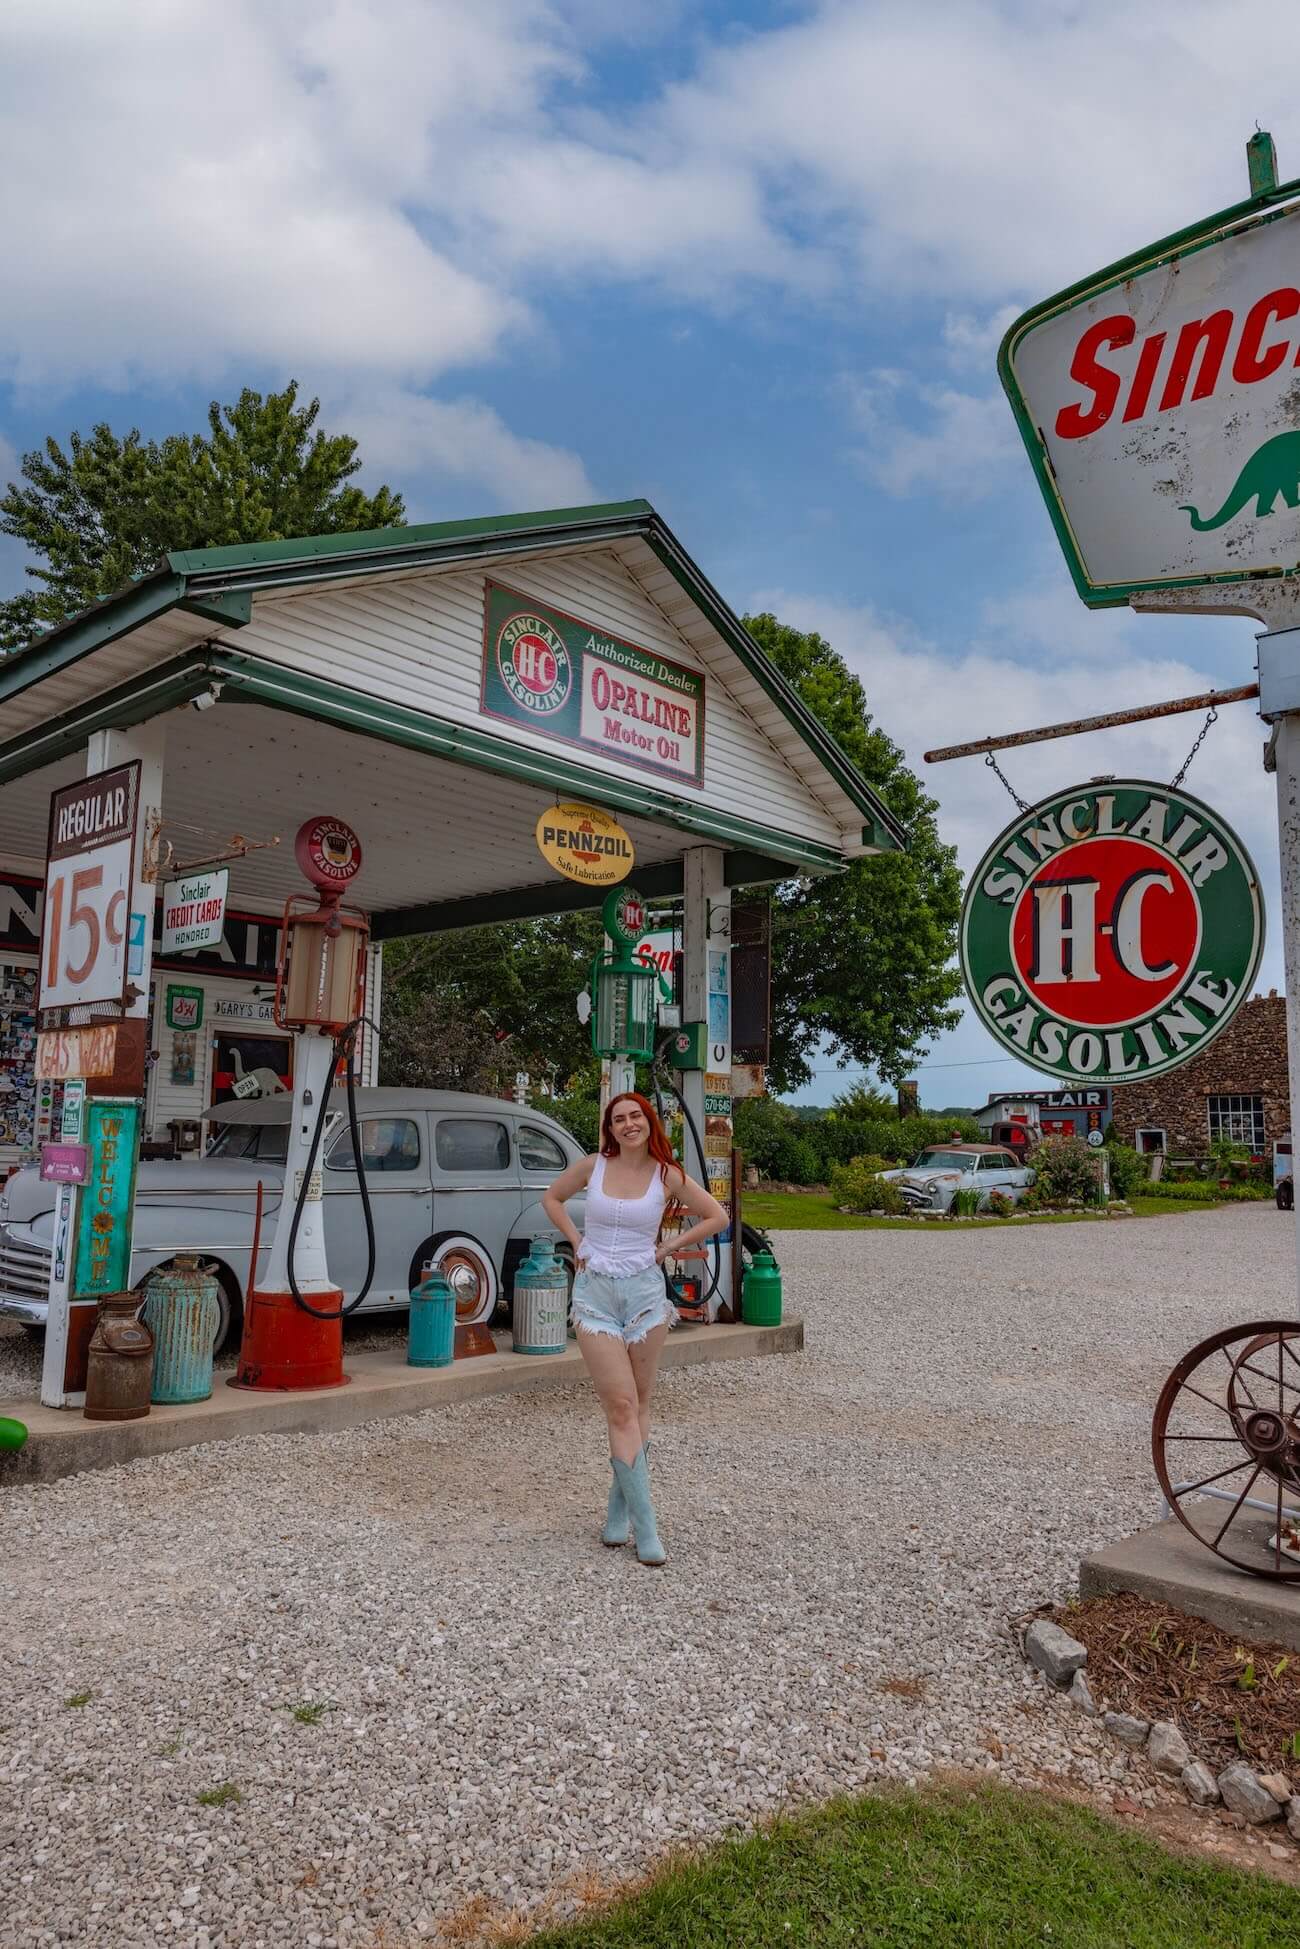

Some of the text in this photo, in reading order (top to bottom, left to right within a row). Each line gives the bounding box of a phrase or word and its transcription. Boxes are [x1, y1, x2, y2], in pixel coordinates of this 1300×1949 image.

[1055, 287, 1300, 439] Sinc
[503, 617, 568, 667] SINCLAIR
[585, 635, 697, 693] Authorized Dealer
[502, 660, 568, 710] GASOLINE
[591, 666, 691, 738] OPALINE
[602, 715, 681, 762] Motor Oil
[58, 786, 125, 843] REGULAR
[312, 822, 358, 849] SINCLAIR
[313, 852, 359, 878] GASOLINE
[543, 826, 632, 858] PENNZOIL
[984, 796, 1229, 905] SINCLAIR
[180, 881, 211, 902] Sinclair
[556, 855, 616, 881] Safe Lubrication
[166, 898, 222, 929] CREDIT CARDS
[175, 927, 210, 945] HONORED
[1030, 868, 1180, 985] H-C
[220, 1001, 254, 1017] GARY'S
[984, 970, 1237, 1074] GASOLINE
[40, 1028, 114, 1077] GAS WAR
[237, 1080, 255, 1095] OPEN
